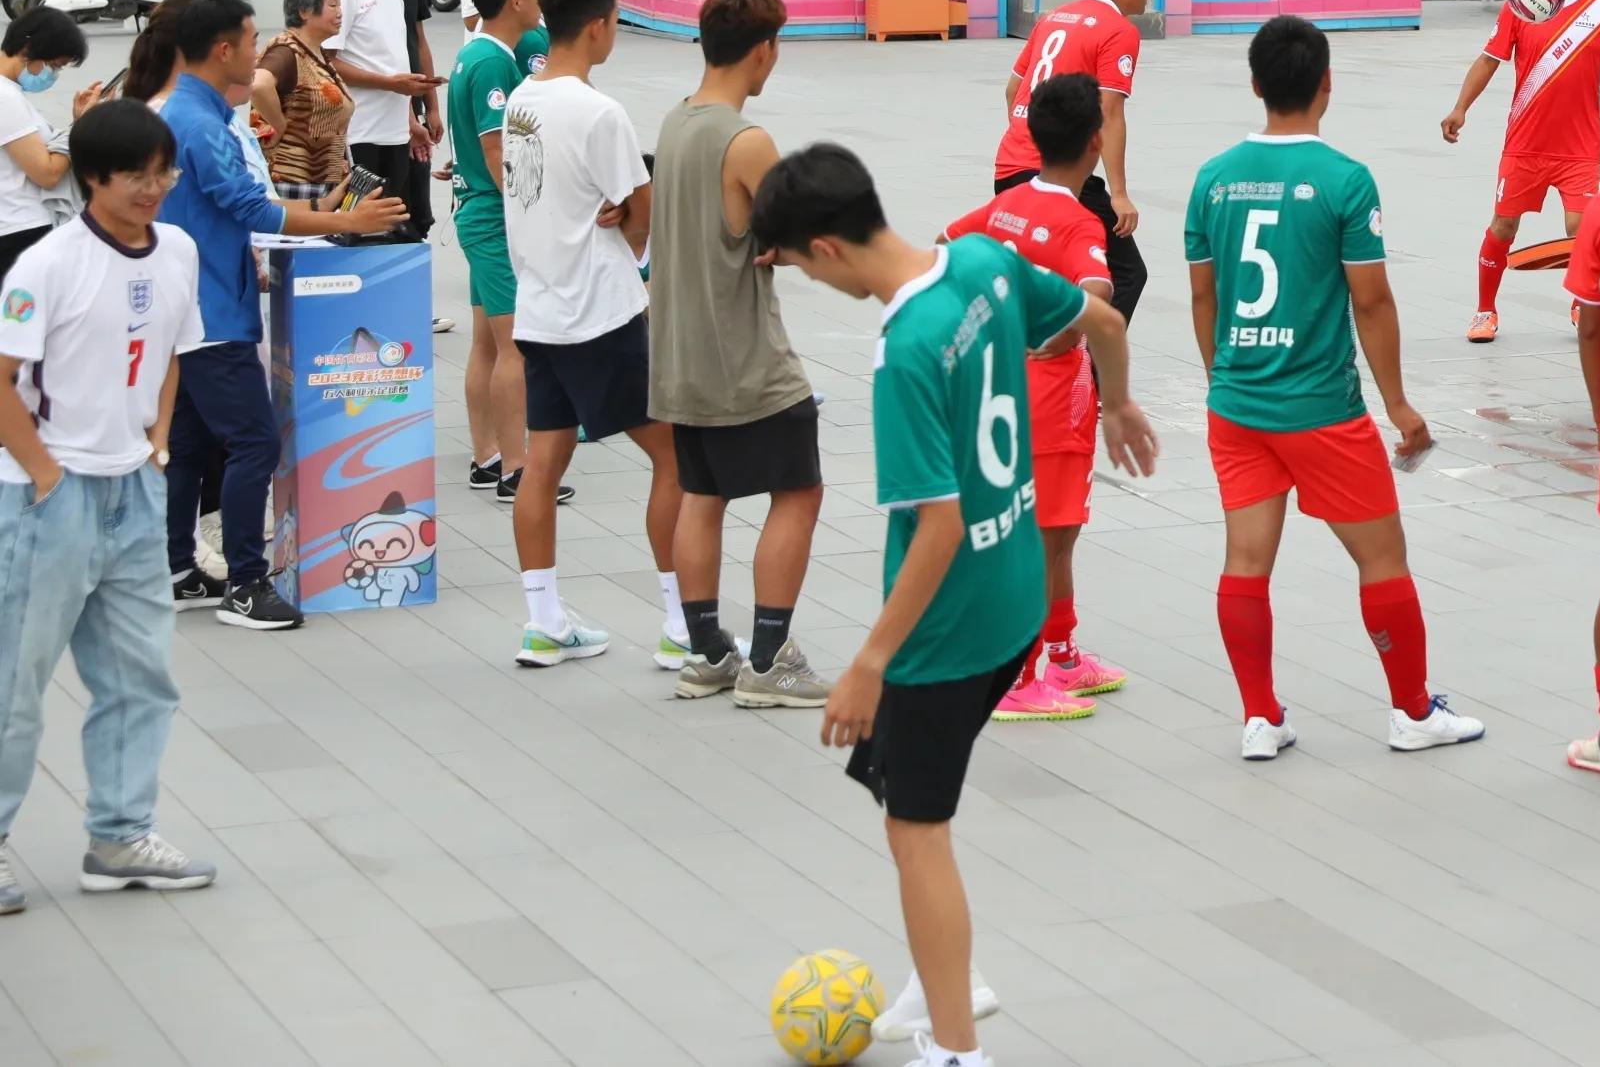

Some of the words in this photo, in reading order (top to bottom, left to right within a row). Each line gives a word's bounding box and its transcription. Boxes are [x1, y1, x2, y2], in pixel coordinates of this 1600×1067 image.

[1030, 29, 1067, 92] 8
[1497, 178, 1505, 202] 4
[1235, 209, 1279, 319] 5
[127, 338, 145, 387] 7
[977, 341, 1018, 488] 6
